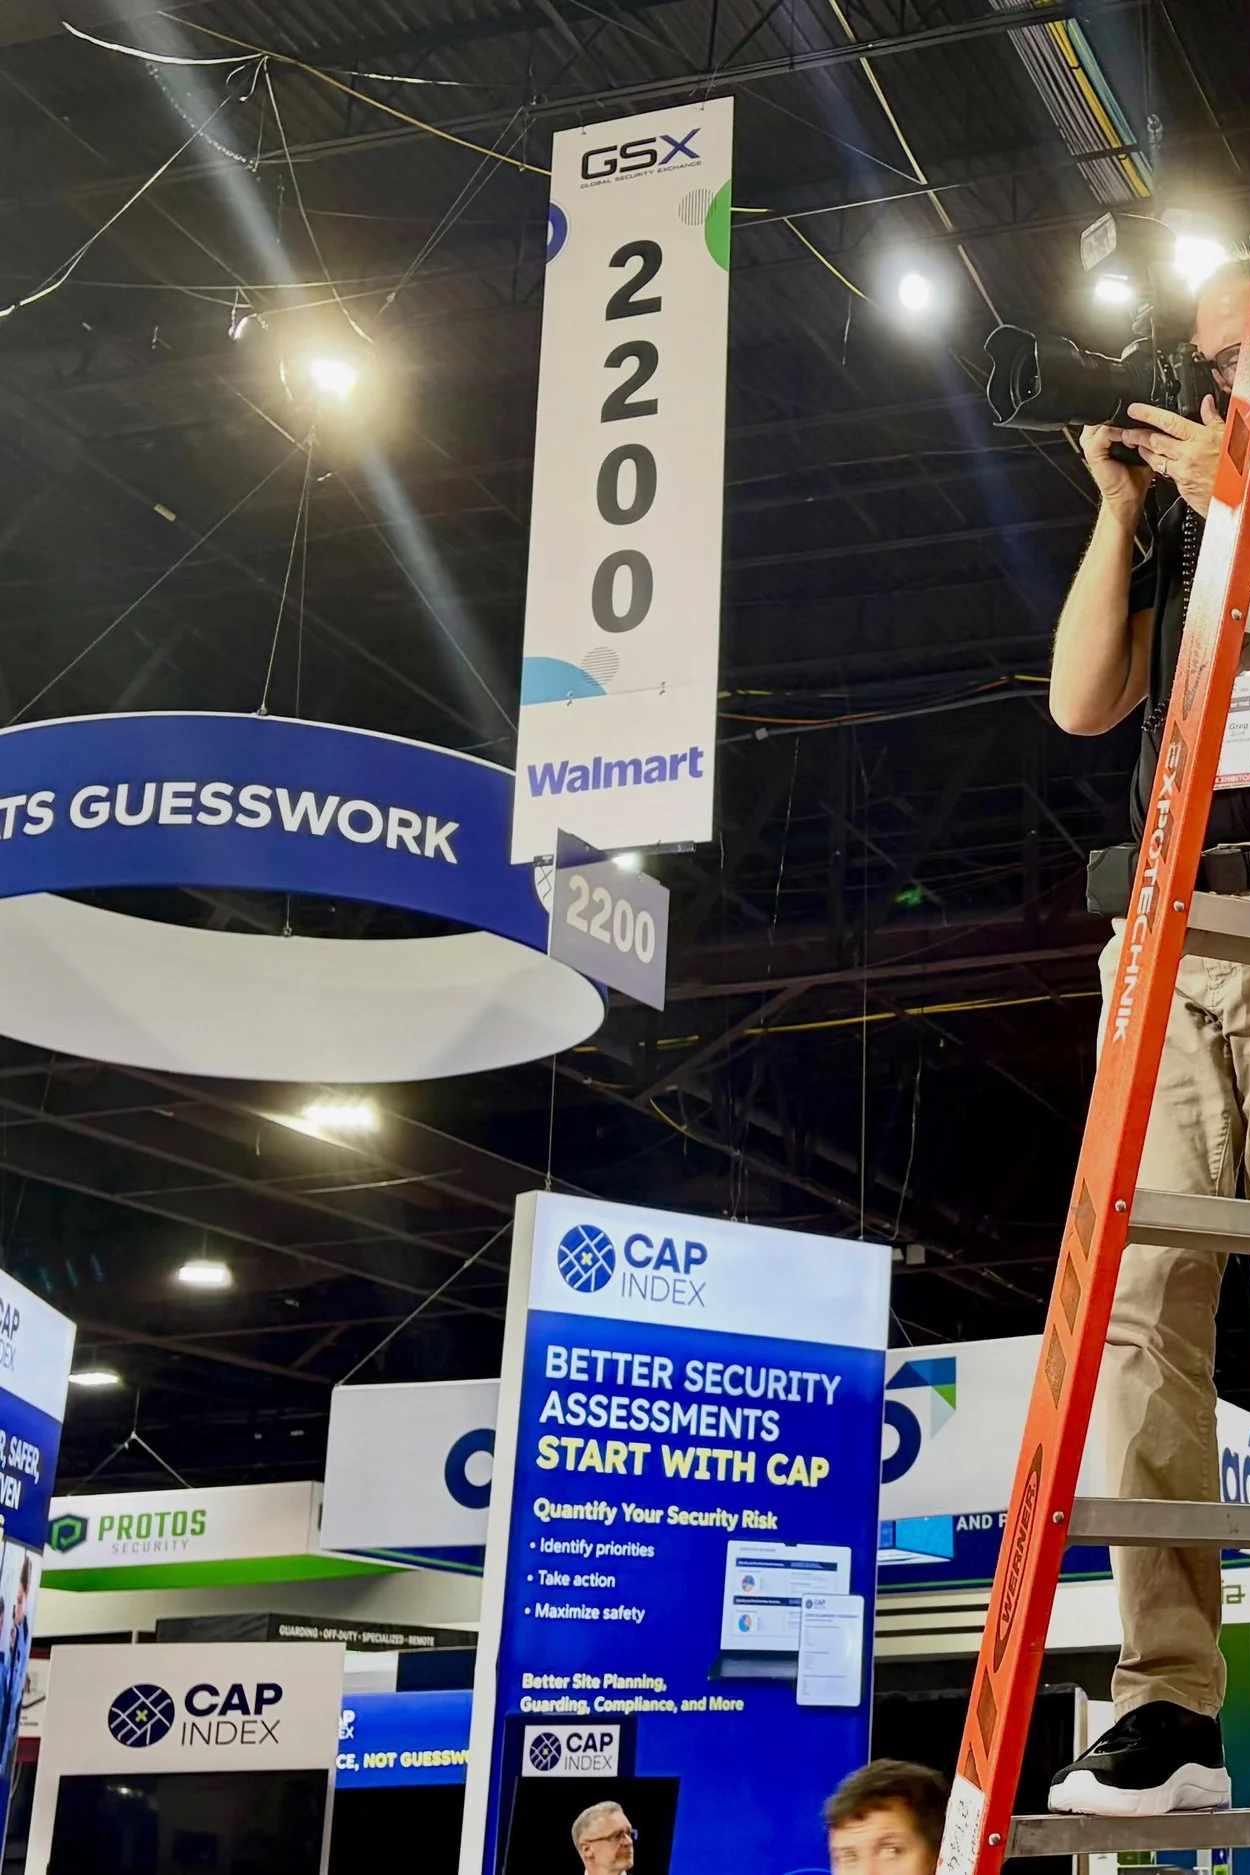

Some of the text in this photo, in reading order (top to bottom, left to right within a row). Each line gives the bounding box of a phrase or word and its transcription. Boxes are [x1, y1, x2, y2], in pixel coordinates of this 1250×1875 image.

[581, 128, 702, 180] GSX
[580, 160, 702, 189] GLOBAL SECURITY EXCHANGE
[527, 747, 703, 798] Walmart
[69, 780, 460, 864] GUESSWORK
[1112, 741, 1182, 1043] EXPOTECHNIK
[565, 873, 656, 965] 2200
[624, 1233, 708, 1275] CAP
[621, 1271, 707, 1308] INDEX
[545, 1344, 841, 1405] BETTER SECURITY
[539, 1391, 780, 1442] ASSESSMENTS
[8, 1434, 40, 1485] SAFER,
[536, 1435, 651, 1476] START
[662, 1444, 756, 1483] WITH
[766, 1453, 830, 1488] CAP
[99, 1509, 207, 1541] PROTOS
[533, 1498, 778, 1531] Quantify Your Security Risk
[956, 1514, 994, 1531] AND
[111, 1538, 190, 1555] SECURITY
[540, 1538, 655, 1558] Identify priorities
[538, 1570, 616, 1588] Take action
[534, 1603, 646, 1624] Maximize safety
[279, 1625, 436, 1647] GUARDING OFF-DUTY SPECIALIZED REMOTE
[522, 1673, 667, 1693] Better Site Planning,
[184, 1682, 283, 1717] CAP
[520, 1697, 744, 1714] Guarding, Compliance, and More
[180, 1719, 281, 1747] INDEX
[566, 1732, 614, 1752] CAP
[363, 1752, 398, 1768] NOT
[563, 1755, 613, 1771] INDEX
